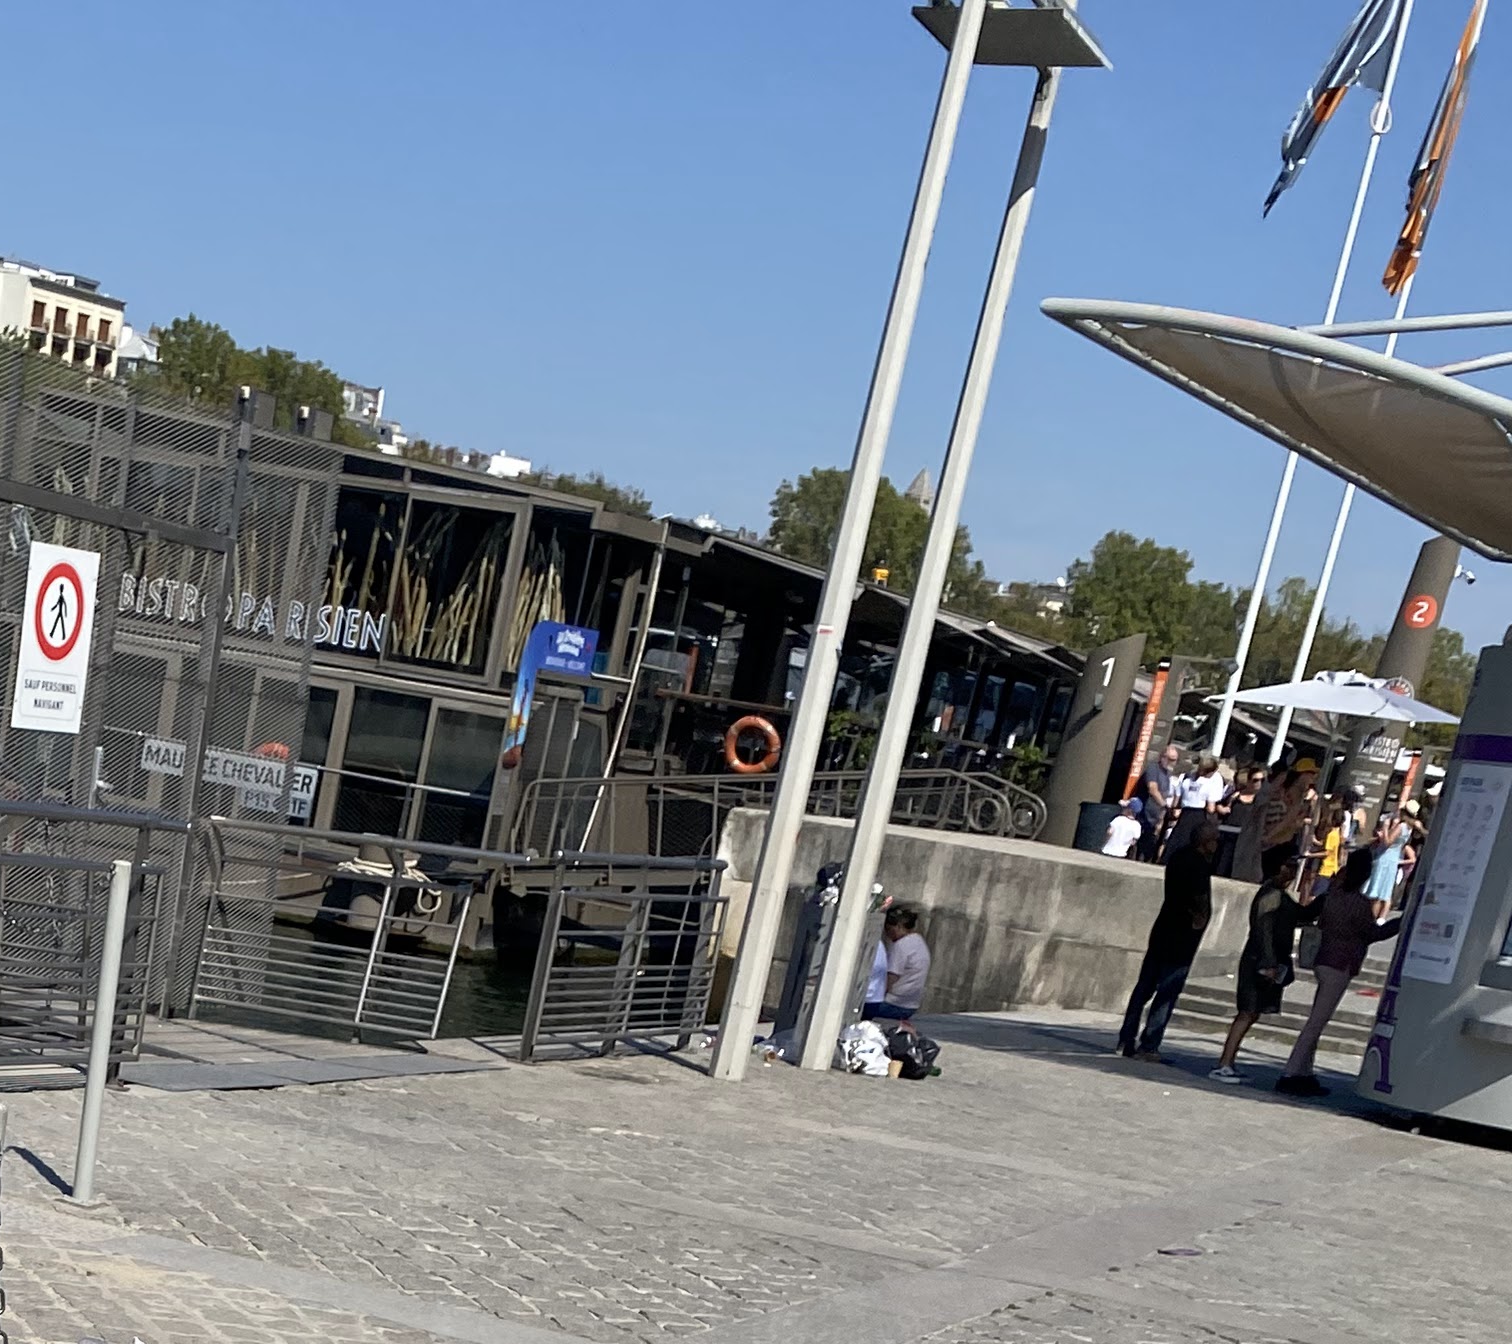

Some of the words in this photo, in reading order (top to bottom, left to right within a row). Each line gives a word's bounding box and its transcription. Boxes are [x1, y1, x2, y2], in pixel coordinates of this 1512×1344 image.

[237, 591, 387, 652] PARISIEN
[1410, 601, 1429, 623] 2
[1102, 657, 1115, 687] 1
[24, 678, 41, 690] SAUF
[41, 679, 77, 694] PERSONNEL
[33, 698, 64, 710] NAVIGANT
[222, 758, 314, 794] CHEVALER
